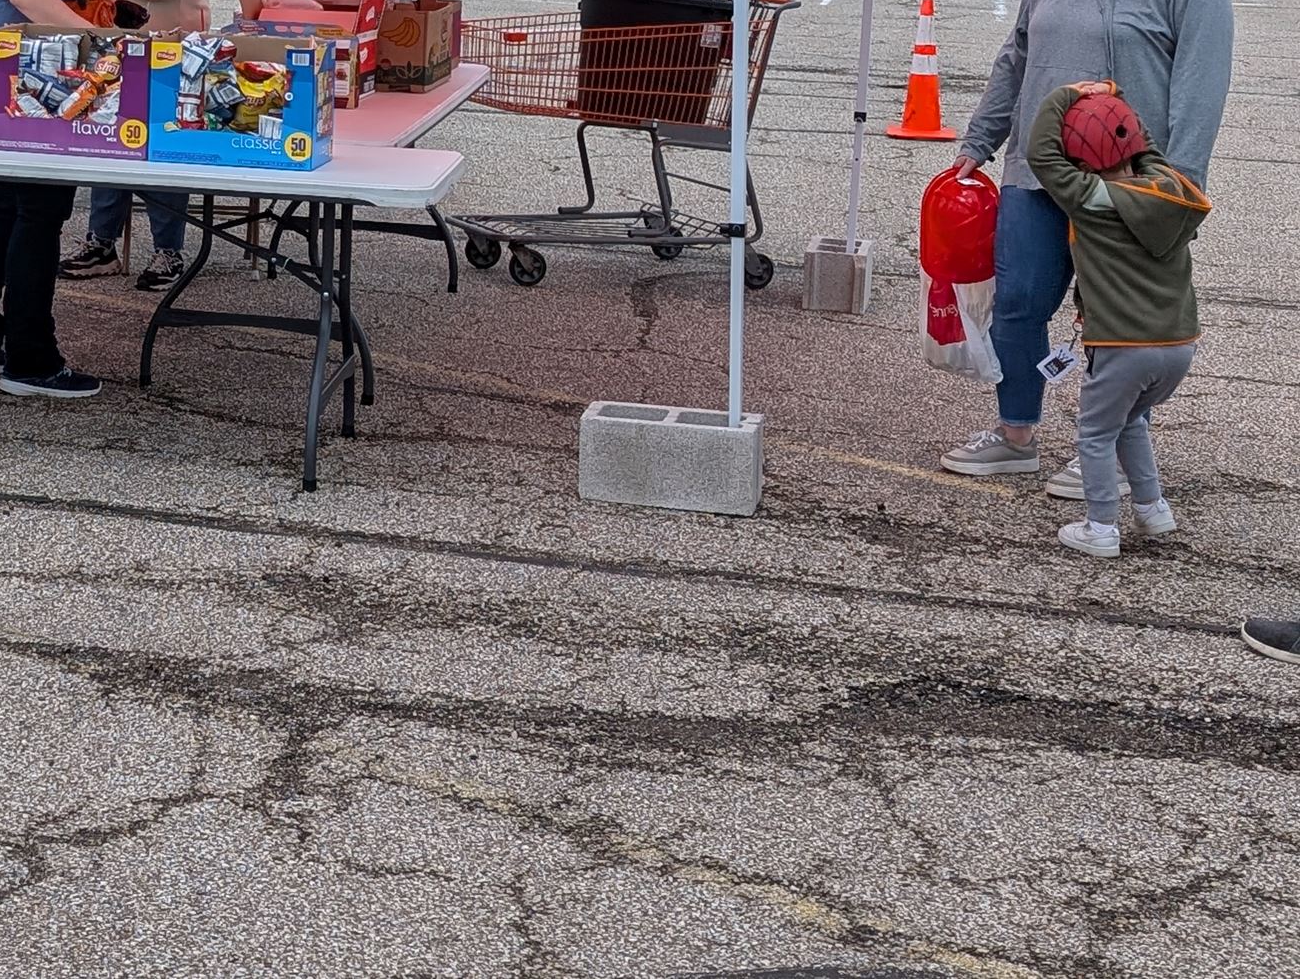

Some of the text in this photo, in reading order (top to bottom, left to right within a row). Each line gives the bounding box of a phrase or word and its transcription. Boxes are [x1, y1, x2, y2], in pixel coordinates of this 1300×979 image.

[72, 121, 141, 139] flavor 50
[231, 135, 306, 152] classic 50
